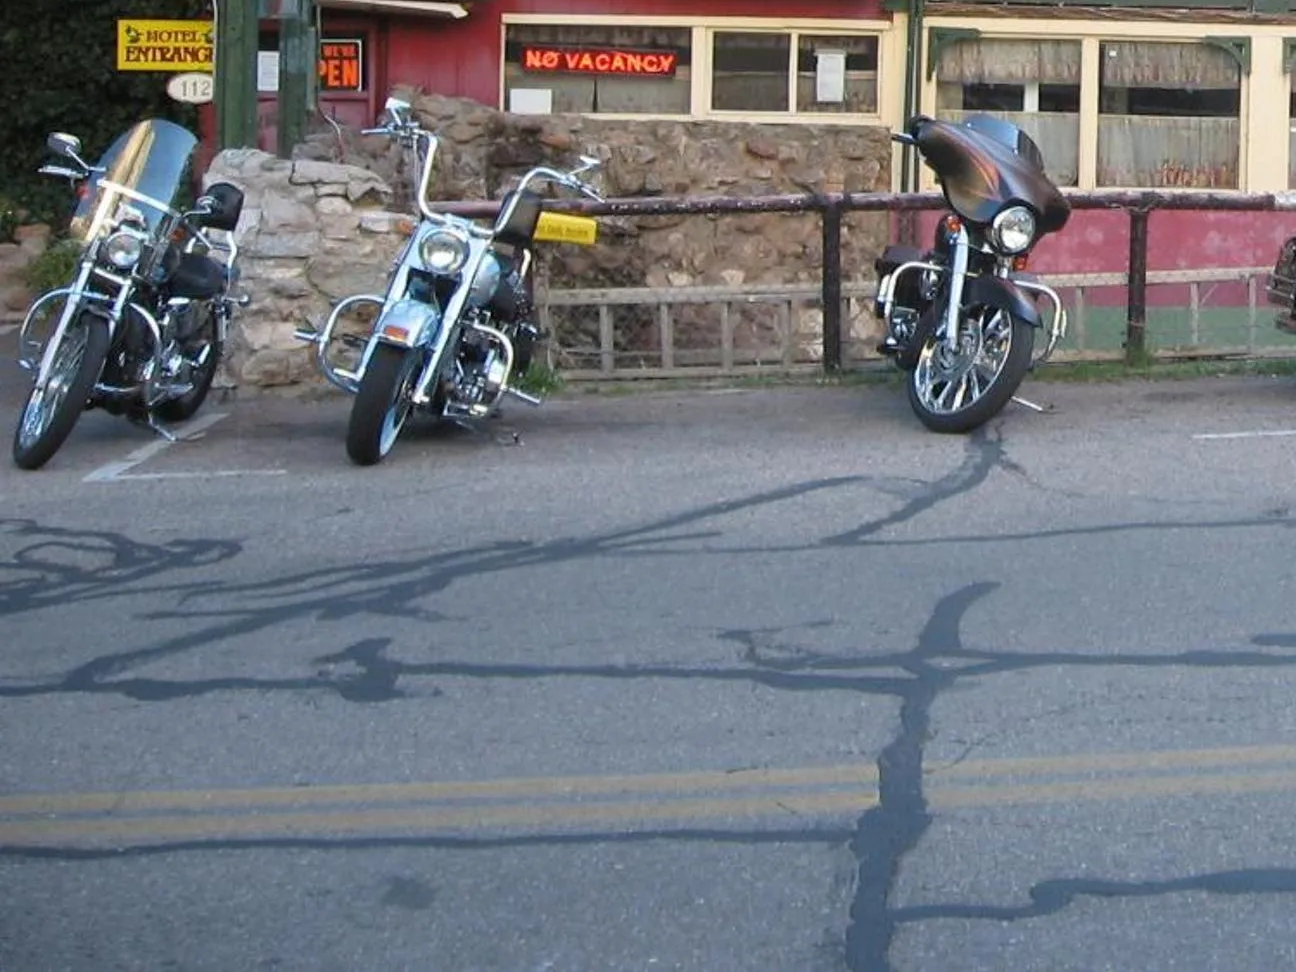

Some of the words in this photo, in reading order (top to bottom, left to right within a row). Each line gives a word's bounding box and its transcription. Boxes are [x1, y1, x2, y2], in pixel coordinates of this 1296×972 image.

[145, 30, 201, 43] HOTEL
[525, 49, 561, 69] NO
[564, 51, 675, 73] VACANCY
[317, 59, 359, 87] PEN
[181, 79, 211, 97] 112
